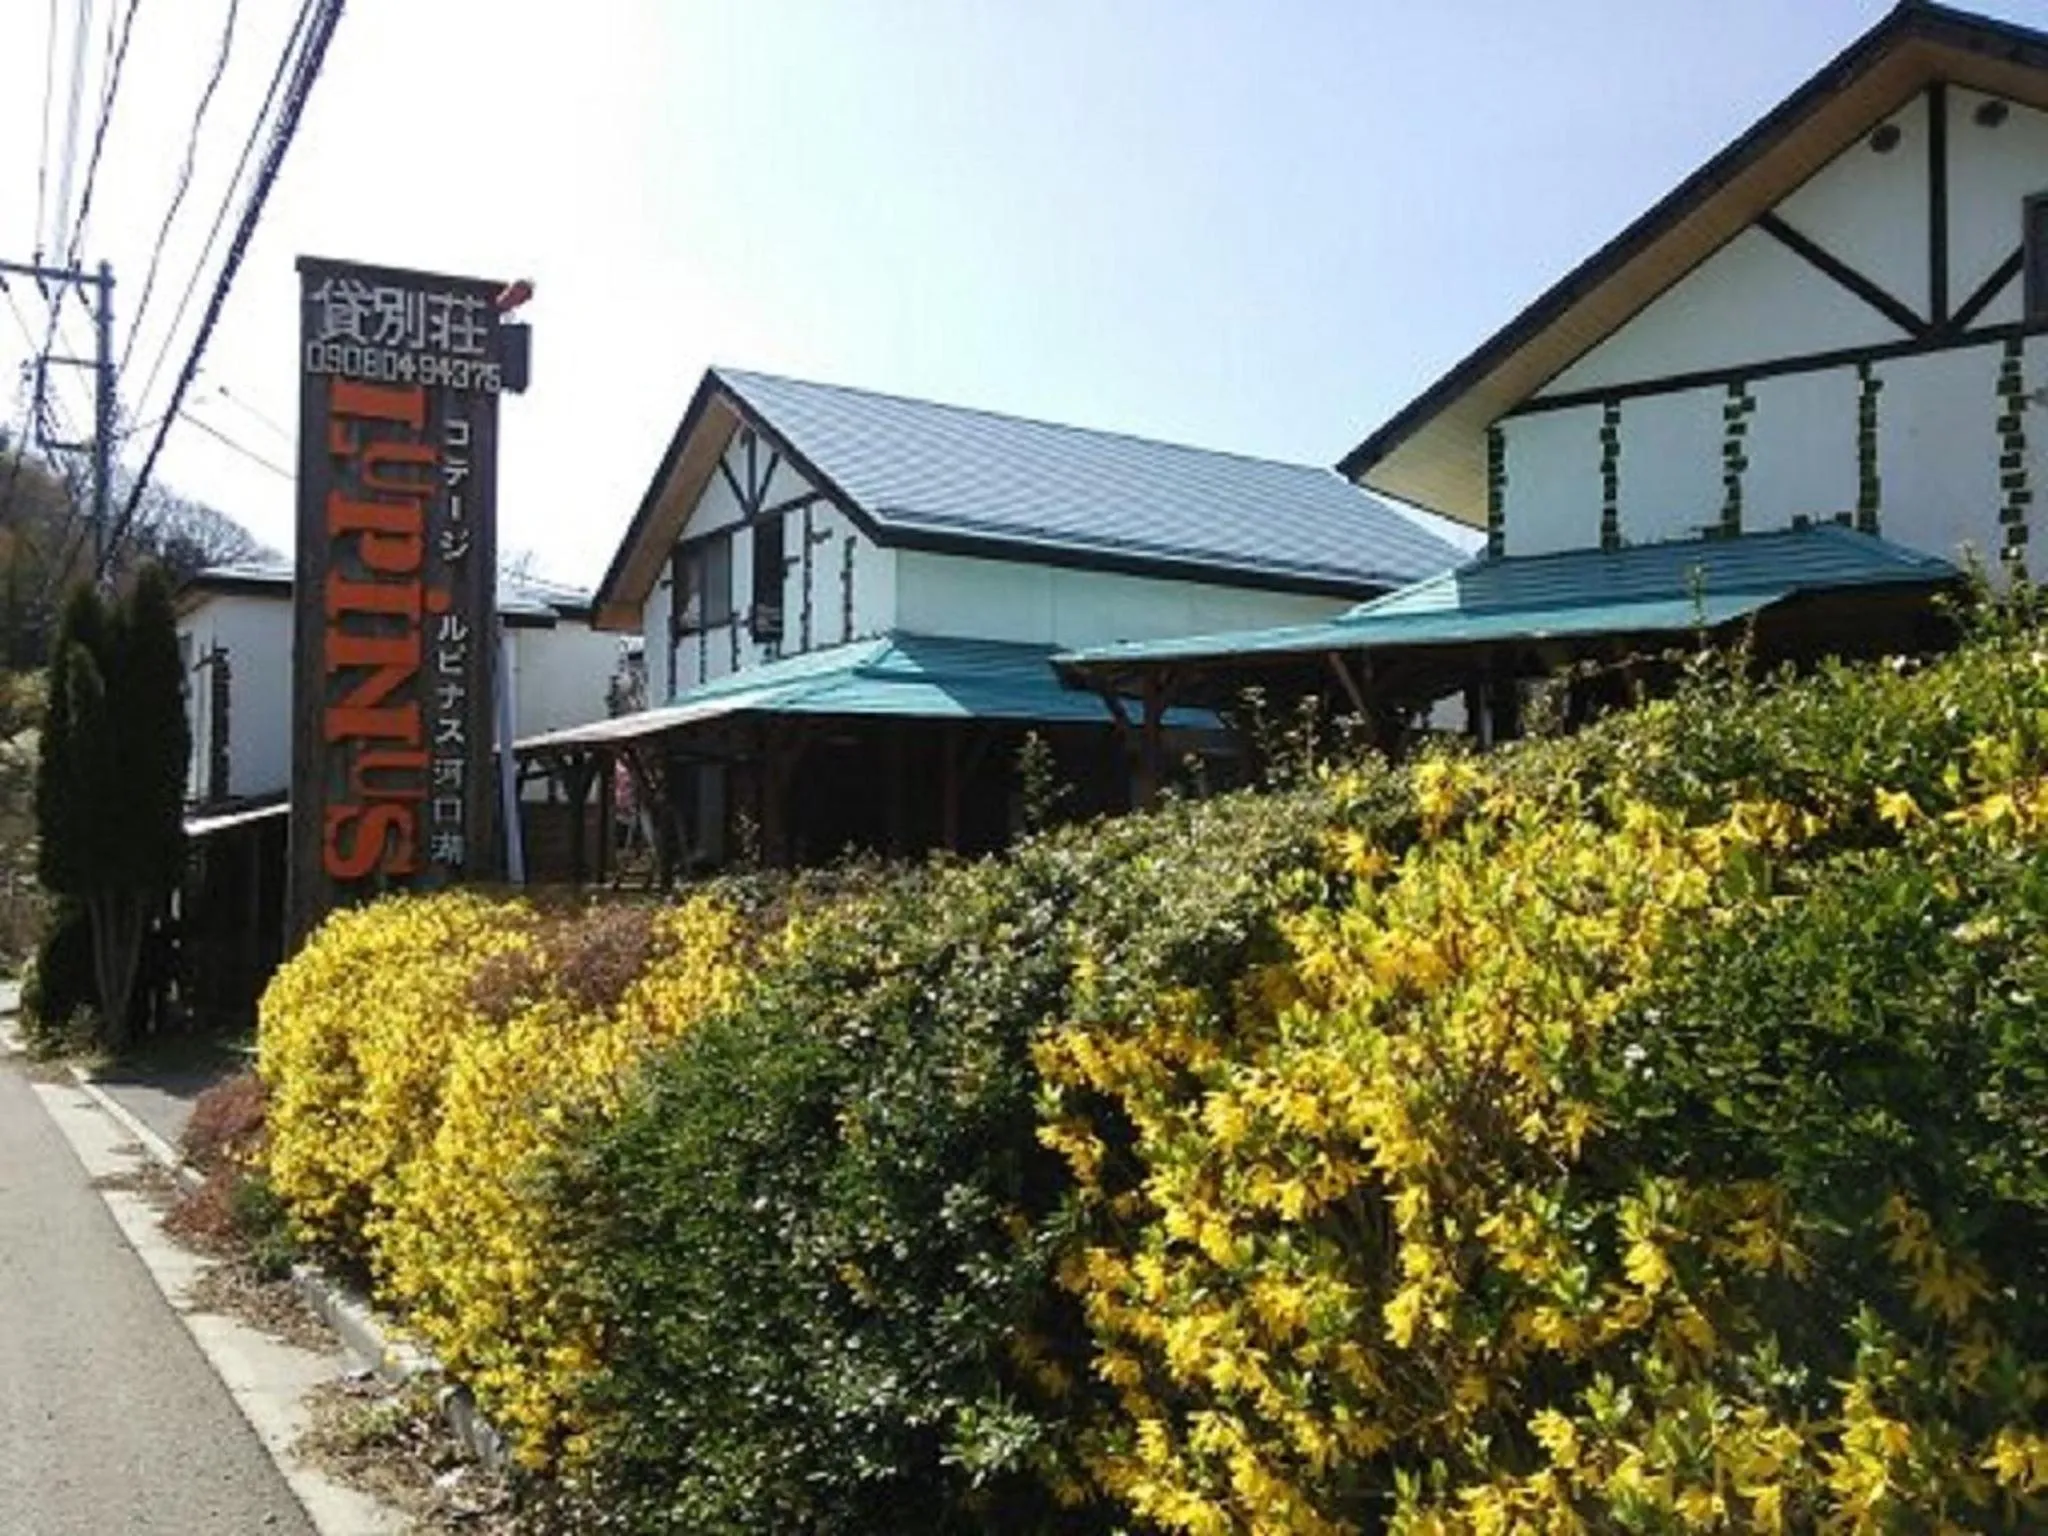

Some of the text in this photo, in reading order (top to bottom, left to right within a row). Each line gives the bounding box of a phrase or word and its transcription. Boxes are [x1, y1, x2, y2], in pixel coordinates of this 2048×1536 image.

[311, 278, 488, 355] 貸別荘
[440, 419, 470, 561] コテージ
